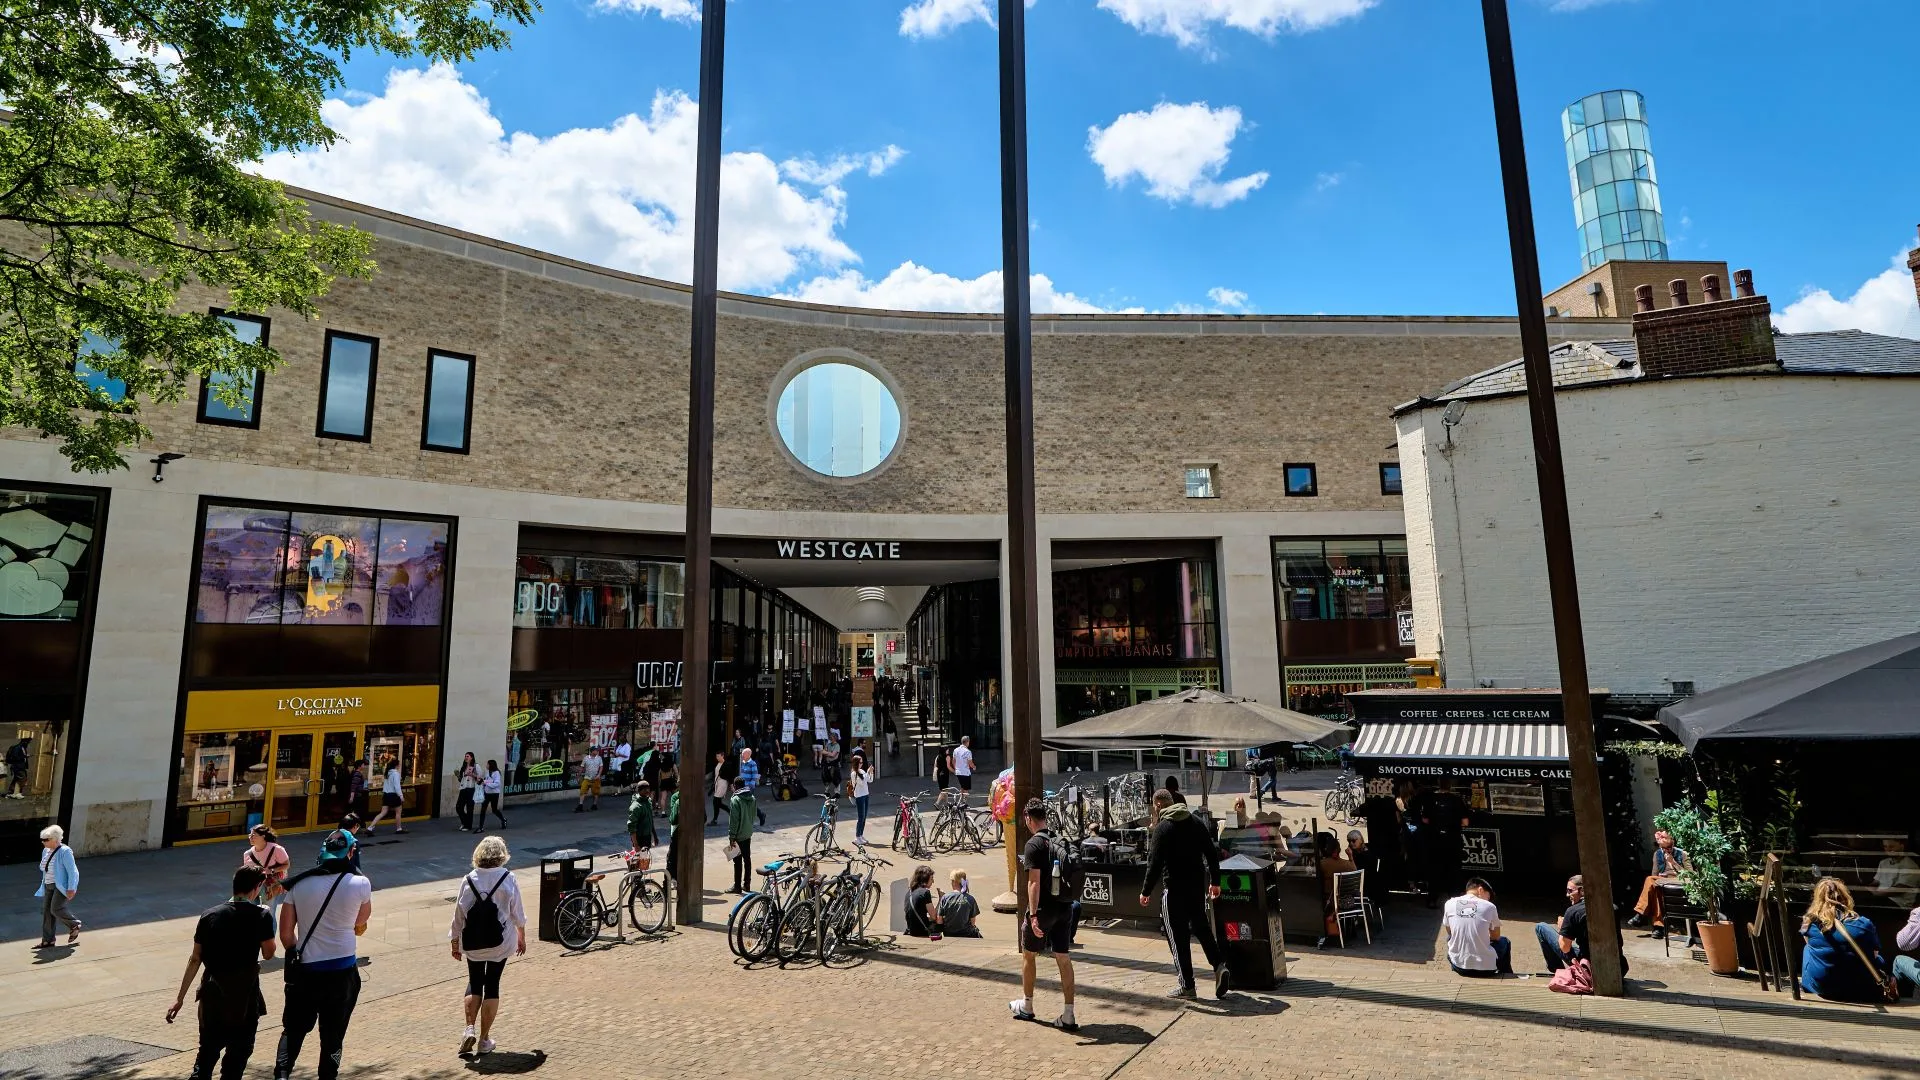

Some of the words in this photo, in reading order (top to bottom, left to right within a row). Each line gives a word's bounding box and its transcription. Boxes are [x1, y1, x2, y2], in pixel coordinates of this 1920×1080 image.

[777, 541, 900, 558] WESTGATE
[518, 581, 560, 612] BDG
[1057, 646, 1109, 658] OMPTOIR
[1291, 684, 1363, 695] COMPTOIR
[277, 696, 363, 710] L'OCCITANE
[307, 708, 346, 716] PROVENCE
[1400, 710, 1438, 718] COFFEE
[1445, 710, 1485, 718] CREPES
[1493, 710, 1510, 718] ICE
[1512, 710, 1550, 718] CREAM
[591, 715, 618, 725] SALE
[590, 727, 617, 748] 50%
[651, 722, 676, 743] 50%
[1378, 766, 1444, 775] SMOOTHIES
[1452, 767, 1531, 777] SANDWICHES
[504, 783, 522, 794] RBAN
[524, 780, 563, 792] OUTFITTERS
[1083, 877, 1103, 889] Art
[1083, 887, 1109, 900] Café
